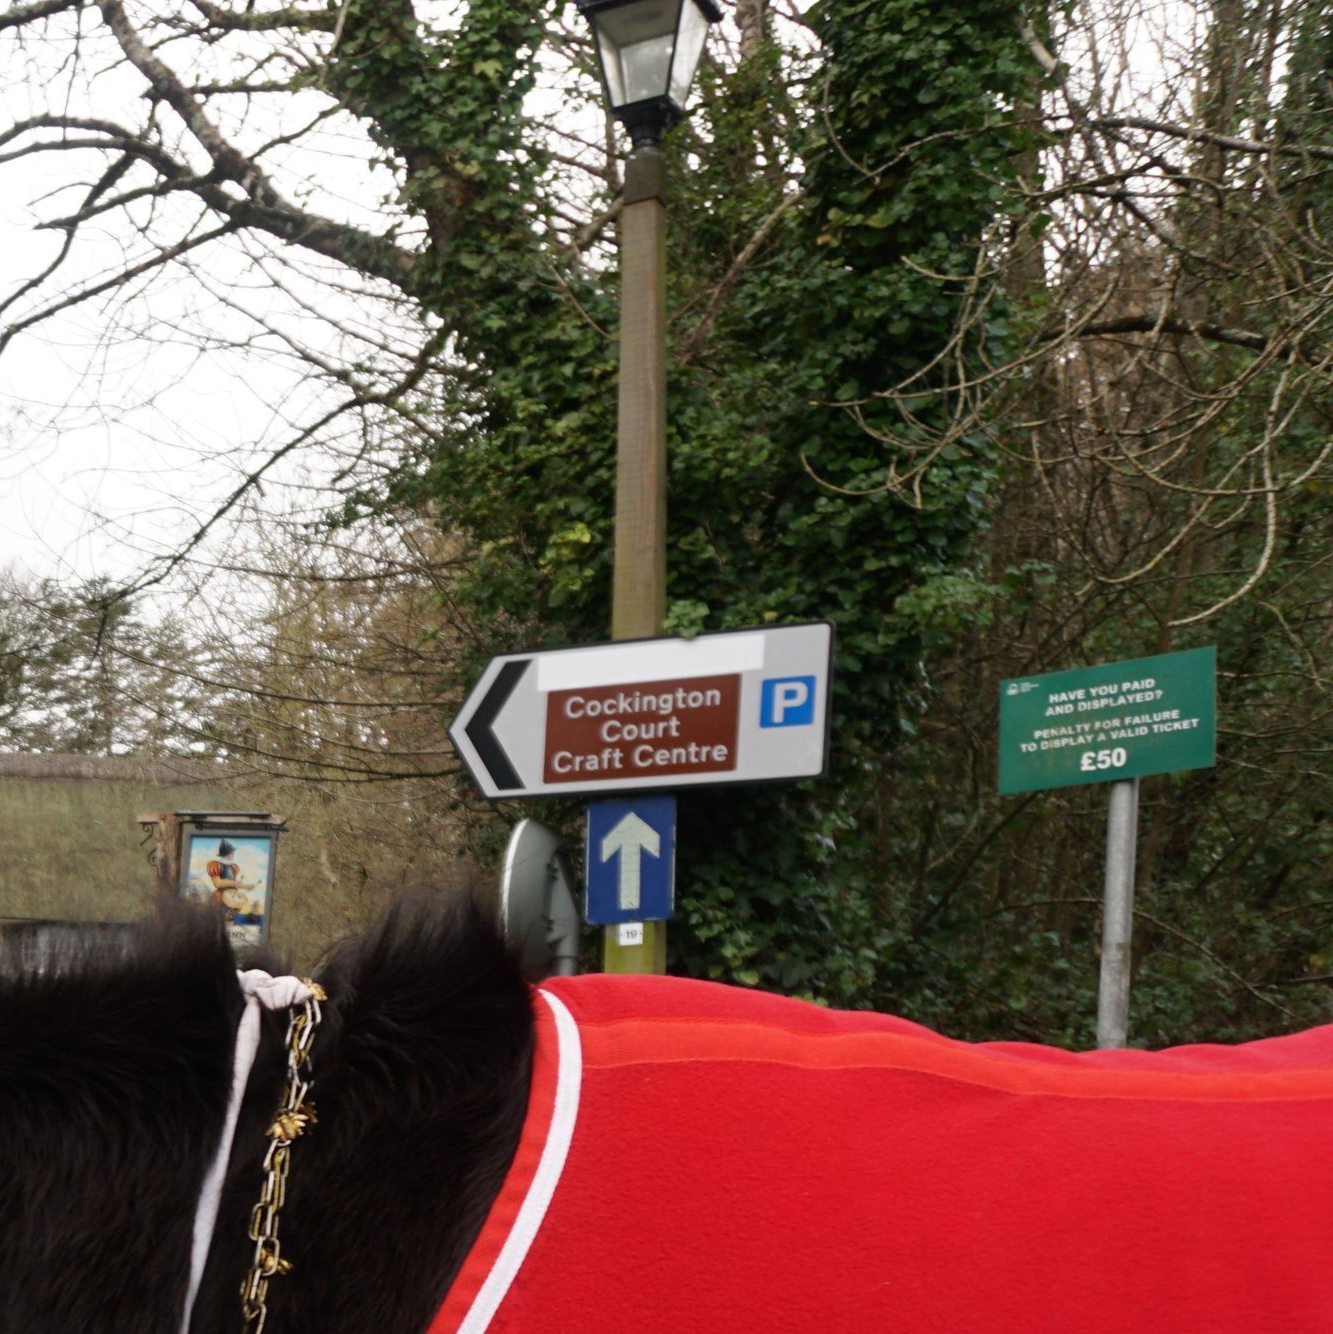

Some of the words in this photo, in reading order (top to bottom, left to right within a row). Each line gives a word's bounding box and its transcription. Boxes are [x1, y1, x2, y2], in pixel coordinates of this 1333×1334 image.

[565, 688, 722, 719] Cockington
[772, 681, 809, 724] P
[1045, 704, 1074, 717] AND
[1078, 689, 1164, 711] DISPLAYED?
[1048, 688, 1086, 704] HAVE
[1089, 683, 1118, 698] YOU
[1122, 678, 1156, 692] PAID
[601, 717, 680, 743] Court
[1020, 742, 1038, 753] TO
[1040, 734, 1095, 751] DISPLAY
[1096, 732, 1107, 743] A
[1110, 726, 1149, 740] VALID
[1152, 718, 1200, 735] TICKET
[1034, 723, 1091, 740] PENALTY
[1094, 718, 1121, 731] FOR
[1124, 709, 1181, 725] FAILURE
[553, 749, 624, 774] Craft
[633, 743, 729, 768] Centre
[1080, 747, 1127, 771] £50
